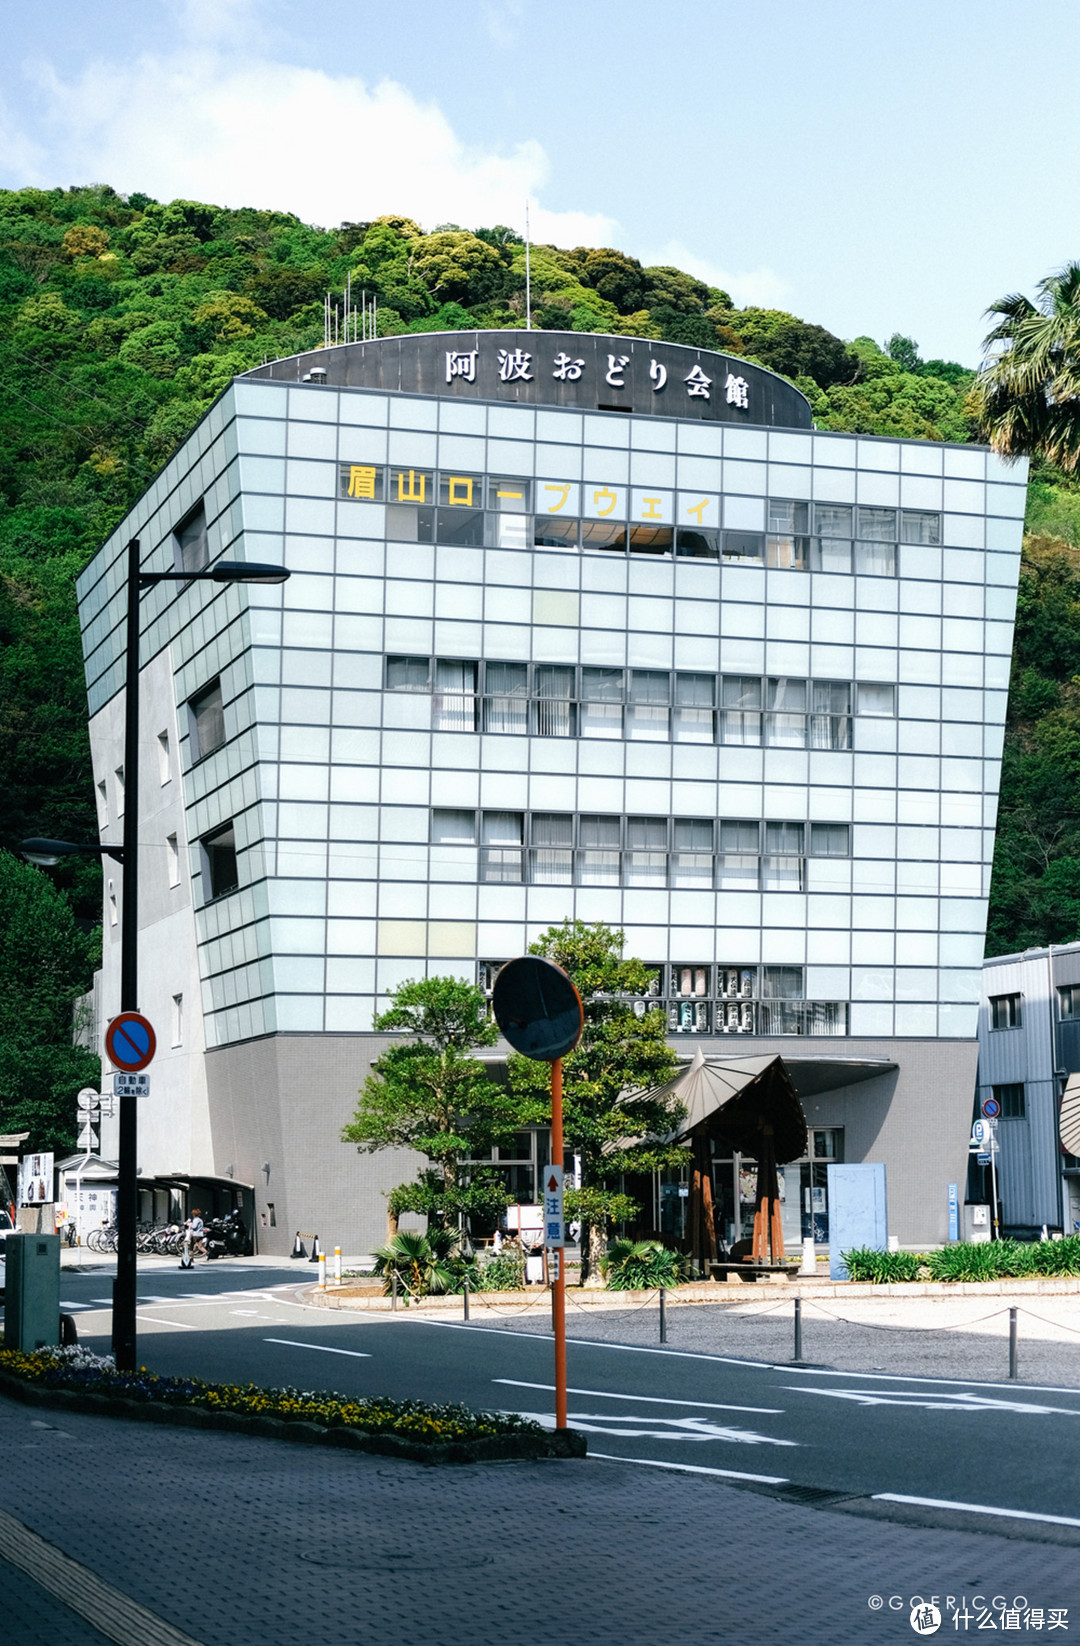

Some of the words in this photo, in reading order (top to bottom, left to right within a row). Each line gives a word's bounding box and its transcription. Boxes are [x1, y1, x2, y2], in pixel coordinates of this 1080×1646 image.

[446, 347, 749, 409] 阿波おどり会館
[348, 466, 710, 524] 眉山ロープウェイ
[118, 1075, 146, 1085] 自動車
[546, 1198, 560, 1240] 注意
